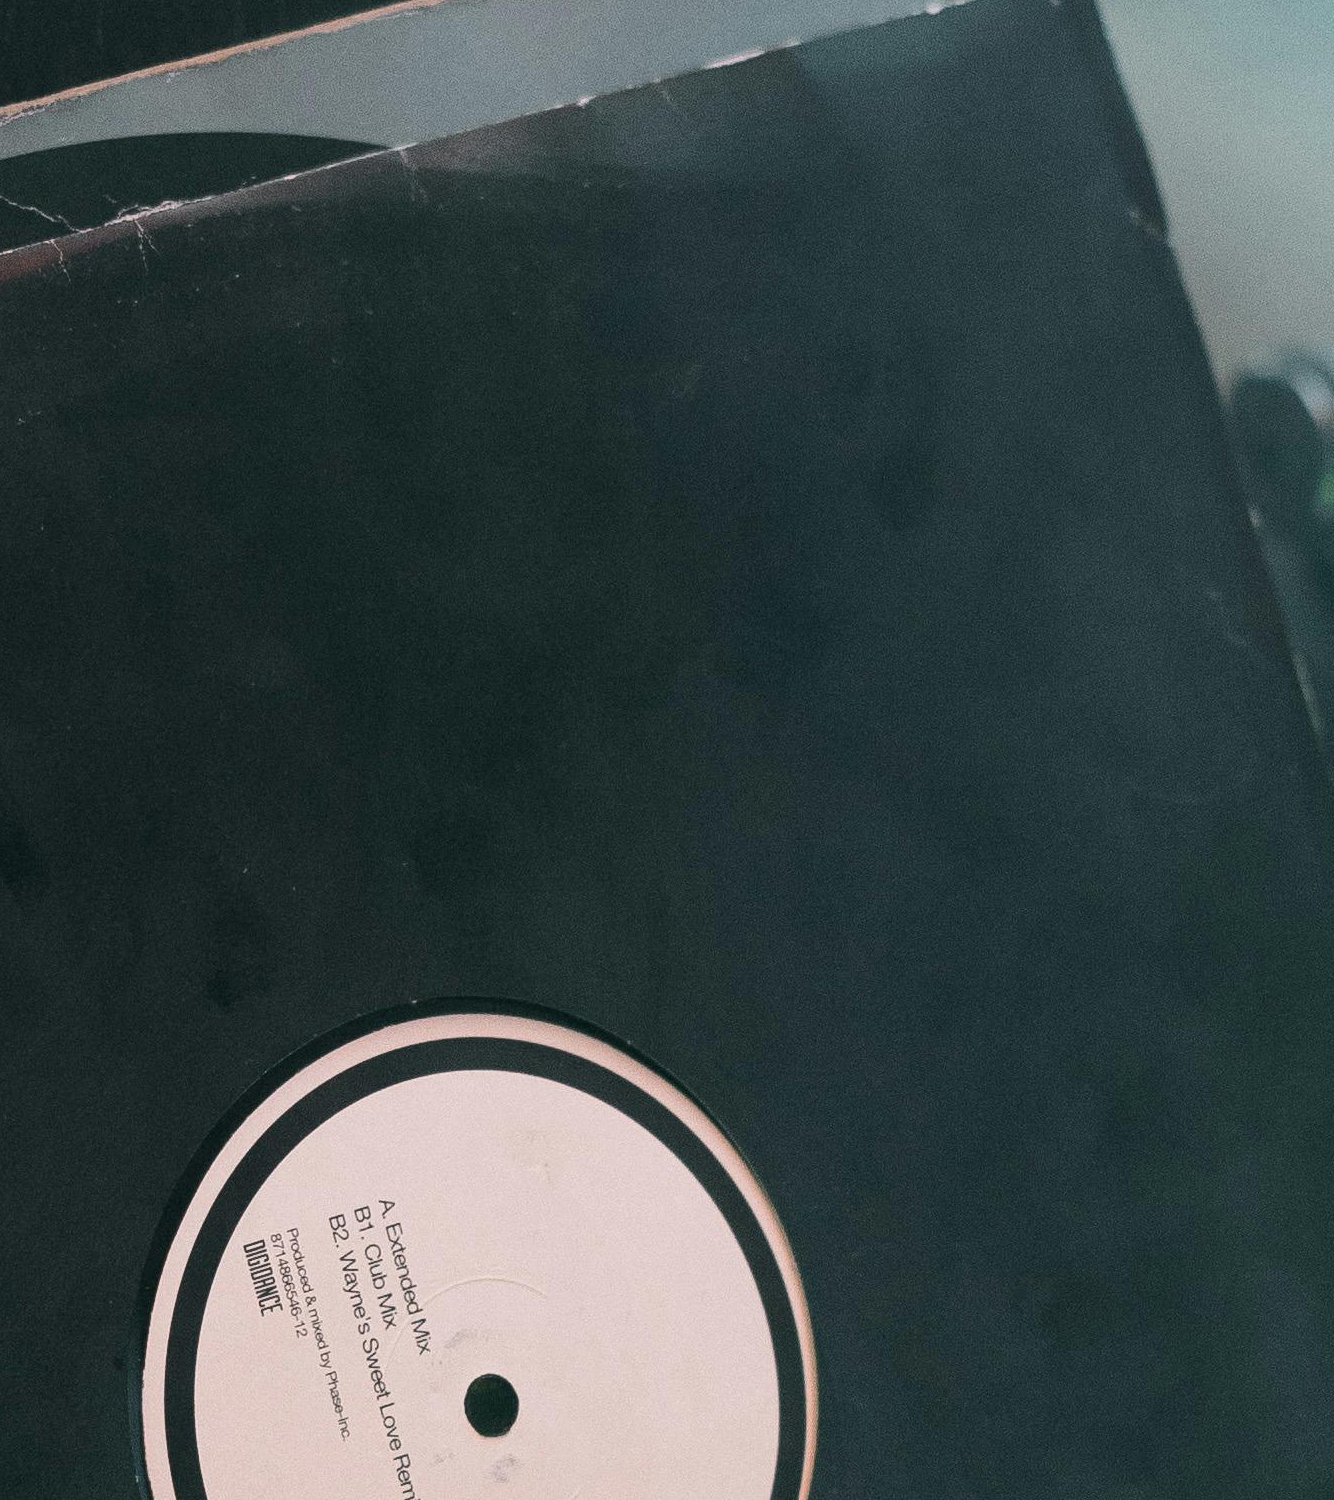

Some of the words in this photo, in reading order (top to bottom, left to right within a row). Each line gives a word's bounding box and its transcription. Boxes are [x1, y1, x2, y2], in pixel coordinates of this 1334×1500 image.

[354, 1205, 375, 1241] B1.
[378, 1199, 396, 1219] A.
[243, 1239, 284, 1318] DIGIDANCE
[287, 1227, 315, 1294] Produced
[364, 1243, 387, 1290] Club
[385, 1222, 424, 1315] Extended
[305, 1295, 318, 1308] &
[377, 1293, 397, 1331] Mix
[308, 1307, 330, 1350] mixed
[328, 1213, 350, 1249] B2.
[339, 1250, 372, 1335] Wayne's
[362, 1337, 392, 1401] Sweet
[380, 1401, 402, 1451] Love
[411, 1318, 432, 1356] Mix
[319, 1350, 332, 1369] by
